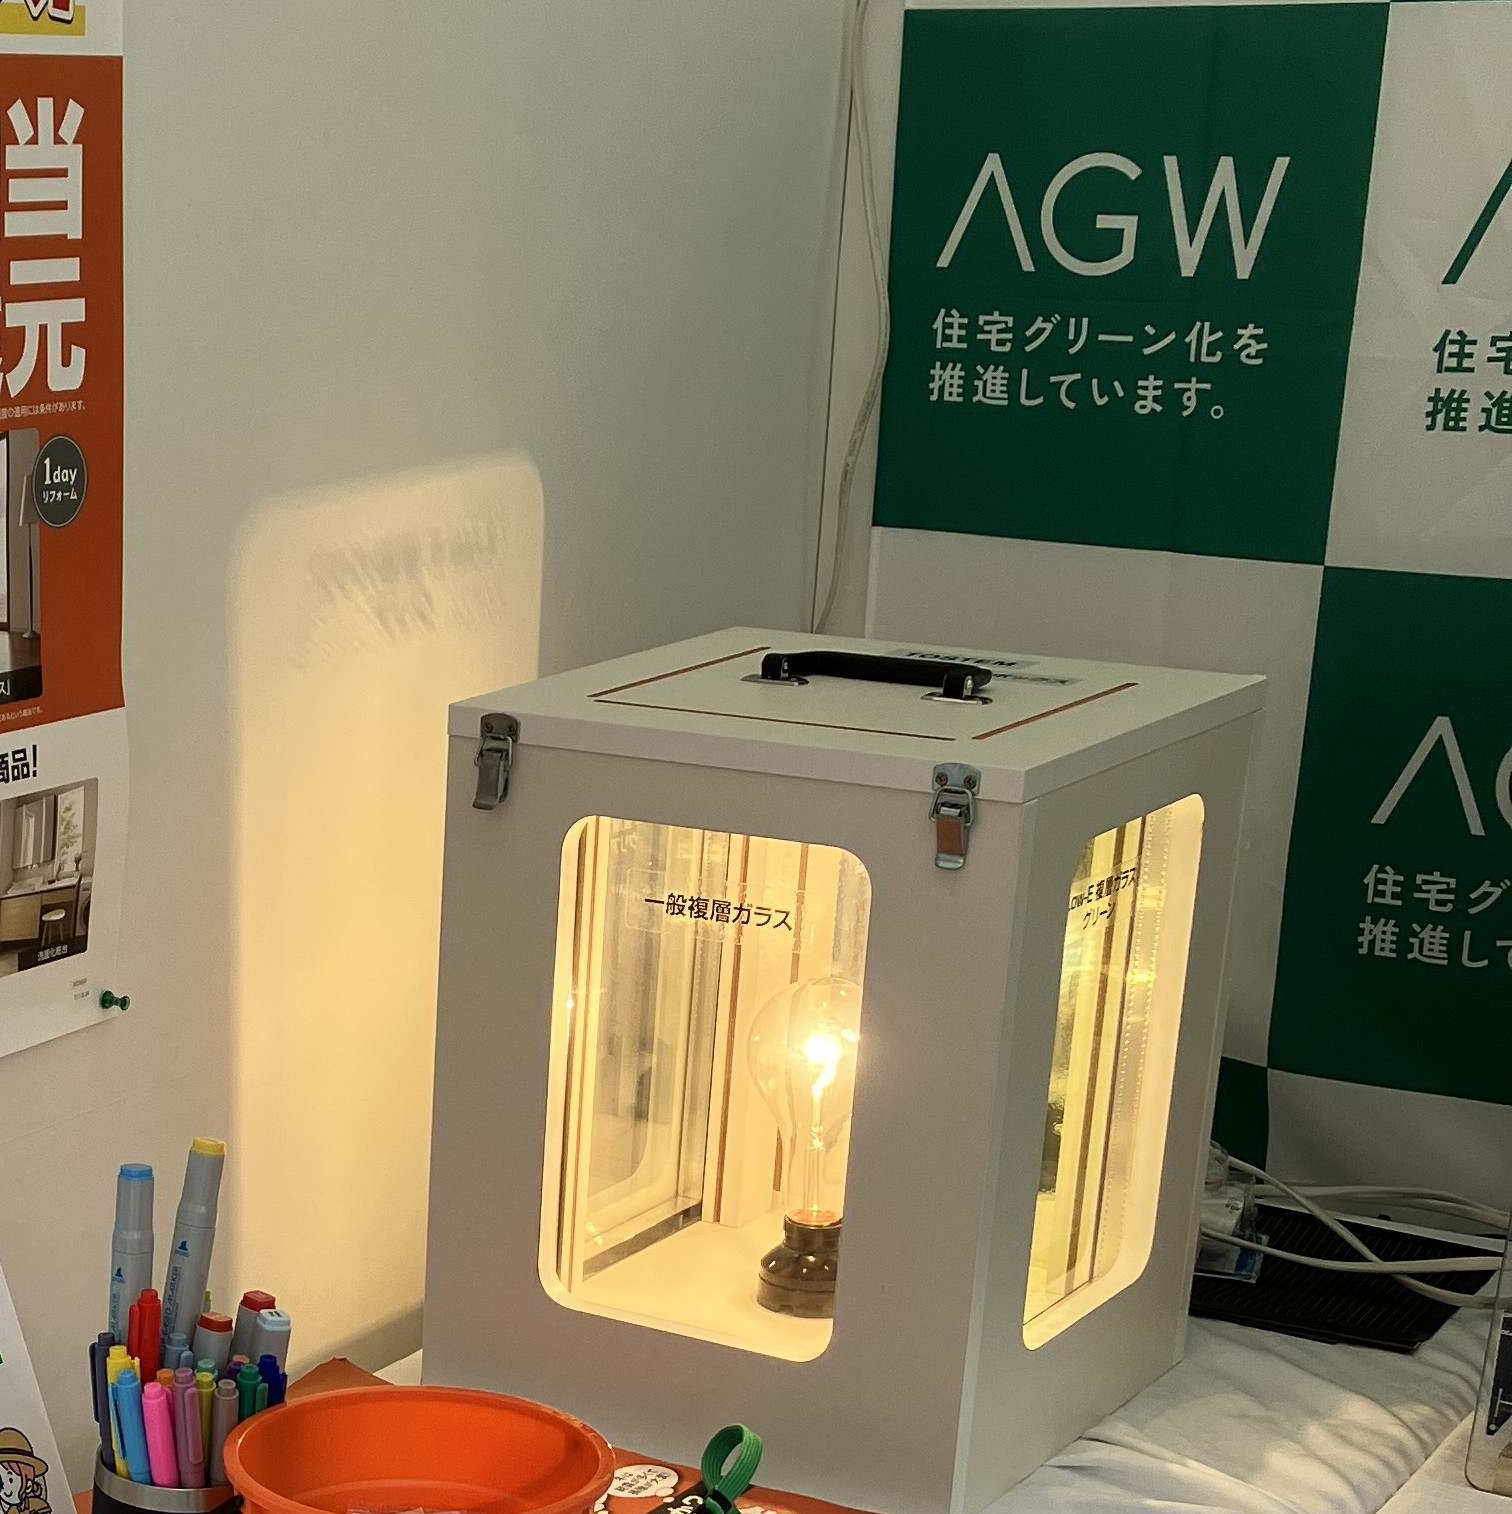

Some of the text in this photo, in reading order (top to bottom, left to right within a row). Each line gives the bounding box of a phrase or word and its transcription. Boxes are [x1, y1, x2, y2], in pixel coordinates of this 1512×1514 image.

[935, 152, 1291, 280] AGW
[931, 308, 1270, 367] 住宅グリーン化を
[928, 361, 1225, 421] 推進しています。
[43, 457, 78, 485] 1day
[42, 488, 78, 504] リフォーム
[644, 892, 793, 932] 一般複層ガラス
